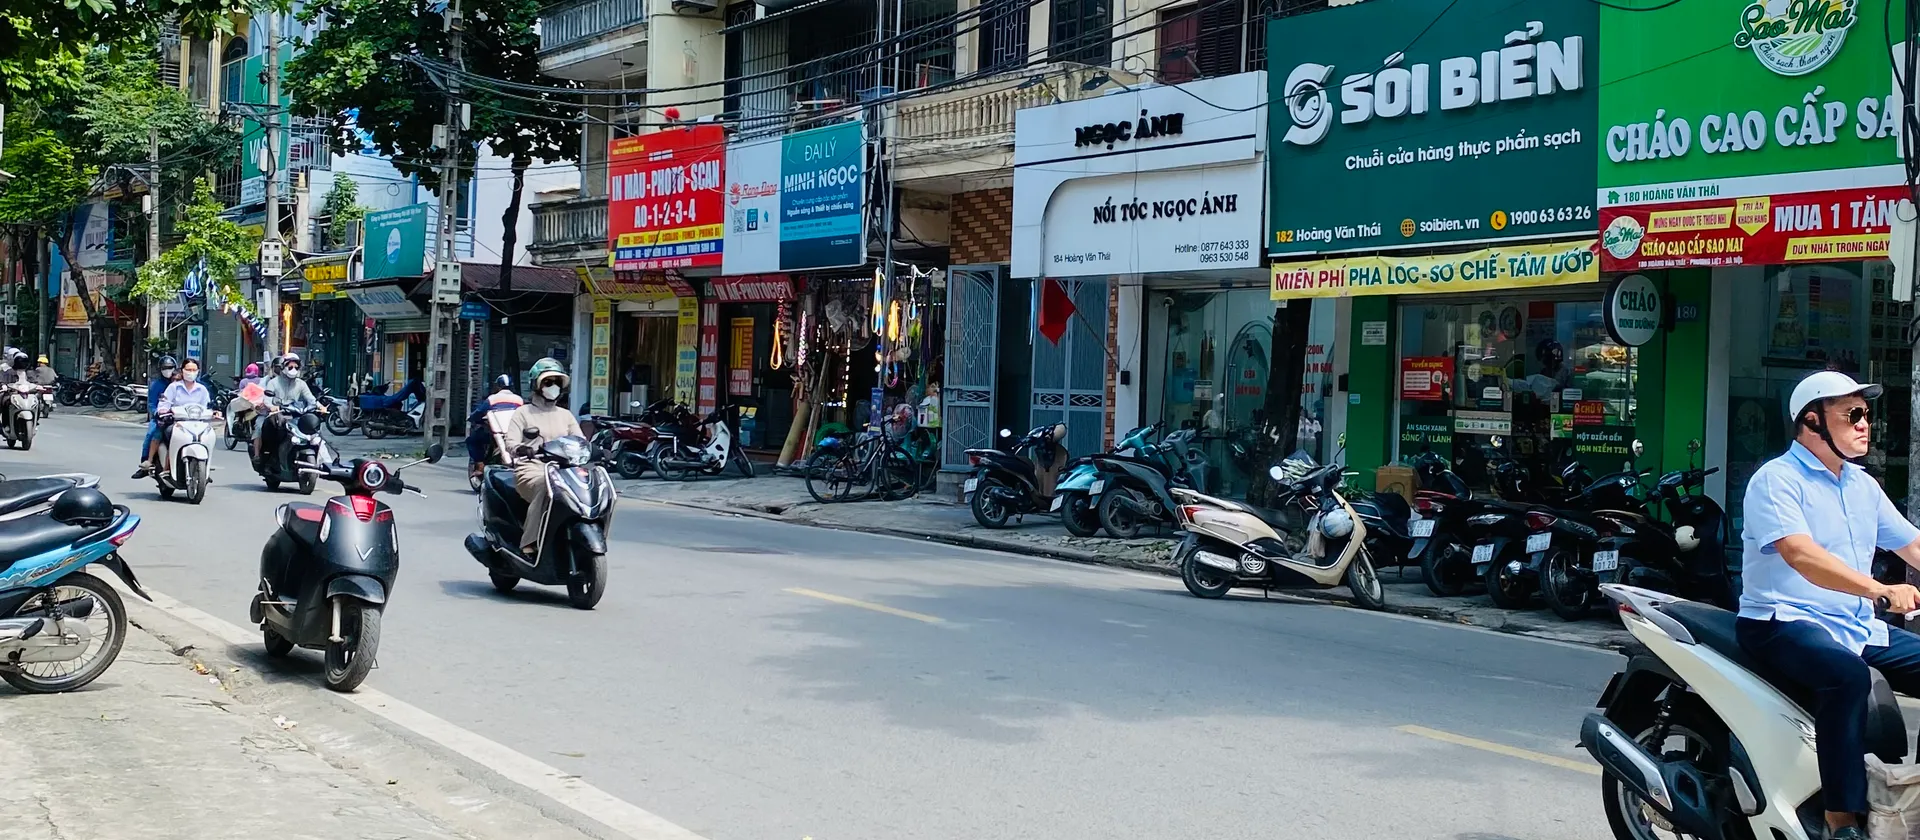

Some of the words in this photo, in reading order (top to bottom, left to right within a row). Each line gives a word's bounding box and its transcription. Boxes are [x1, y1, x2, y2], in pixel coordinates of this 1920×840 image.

[1735, 4, 1789, 46] Sao
[1788, 0, 1853, 34] Mai
[1341, 51, 1429, 124] SÓI
[1440, 21, 1584, 110] BIỂN
[1075, 120, 1132, 150] NGỌC
[1134, 109, 1184, 139] ÁNH
[1606, 108, 1692, 163] CHÁO
[1700, 110, 1767, 154] CAO
[1774, 85, 1848, 147] CẤP
[1856, 95, 1898, 140] SA
[805, 142, 822, 163] ĐẠI
[825, 137, 837, 158] LÝ
[1345, 148, 1384, 170] Chuỗi
[1388, 146, 1414, 165] cửa
[1418, 145, 1454, 162] hàng
[1458, 141, 1491, 159] thực
[1496, 129, 1539, 155] phẩm
[1544, 129, 1581, 150] sạch
[612, 175, 622, 201] IN
[784, 171, 815, 193] MINH
[818, 164, 858, 190] NGỌC
[1624, 191, 1640, 202] 180
[1642, 188, 1675, 201] HOÀNG
[1677, 186, 1696, 199] VĂN
[1698, 184, 1720, 197] THÁI
[1093, 196, 1117, 224] NỐI
[1121, 197, 1148, 222] TÓC
[1152, 198, 1197, 221] NGỌC
[1200, 190, 1238, 215] ÁNH
[1508, 210, 1537, 226] 1900
[1539, 210, 1555, 224] 63
[1557, 208, 1573, 222] 63
[1574, 206, 1591, 220] 26
[1774, 204, 1822, 232] MUA
[1831, 203, 1840, 229] 1
[1850, 195, 1893, 233] TẶN
[1276, 231, 1293, 243] 182
[1296, 227, 1332, 243] Hoàng
[1334, 226, 1356, 240] Văn
[1358, 222, 1381, 238] Thái
[1201, 242, 1219, 252] 0877
[1219, 240, 1234, 251] 643
[1235, 239, 1249, 250] 333
[1641, 237, 1664, 257] CHÁO
[1667, 243, 1685, 255] CAO
[1687, 233, 1705, 255] CẤP
[1706, 242, 1724, 254] SAO
[1726, 237, 1744, 252] MAI
[1793, 244, 1808, 255] DUY
[1811, 241, 1832, 254] NHẤT
[1836, 242, 1863, 253] TRONG
[1064, 253, 1083, 264] Hoàng
[1085, 252, 1096, 261] Văn
[1200, 253, 1218, 263] 0963
[1219, 252, 1233, 262] 530
[1235, 251, 1249, 261] 548
[1276, 267, 1314, 290] MIỄN
[1318, 264, 1346, 288] PHÍ
[1350, 266, 1381, 286] PHA
[1430, 261, 1456, 283] SƠ
[1460, 252, 1501, 280] CHẾ
[1508, 252, 1546, 277] TẨM
[1551, 249, 1594, 274] ƯỚP
[1620, 286, 1657, 312] CHÁO
[704, 303, 717, 326] IN
[1619, 318, 1633, 328] DINH
[1676, 306, 1697, 319] 180
[1411, 359, 1428, 368] TUYỂN
[1576, 432, 1590, 441] MỘT
[1614, 446, 1628, 454] TIN
